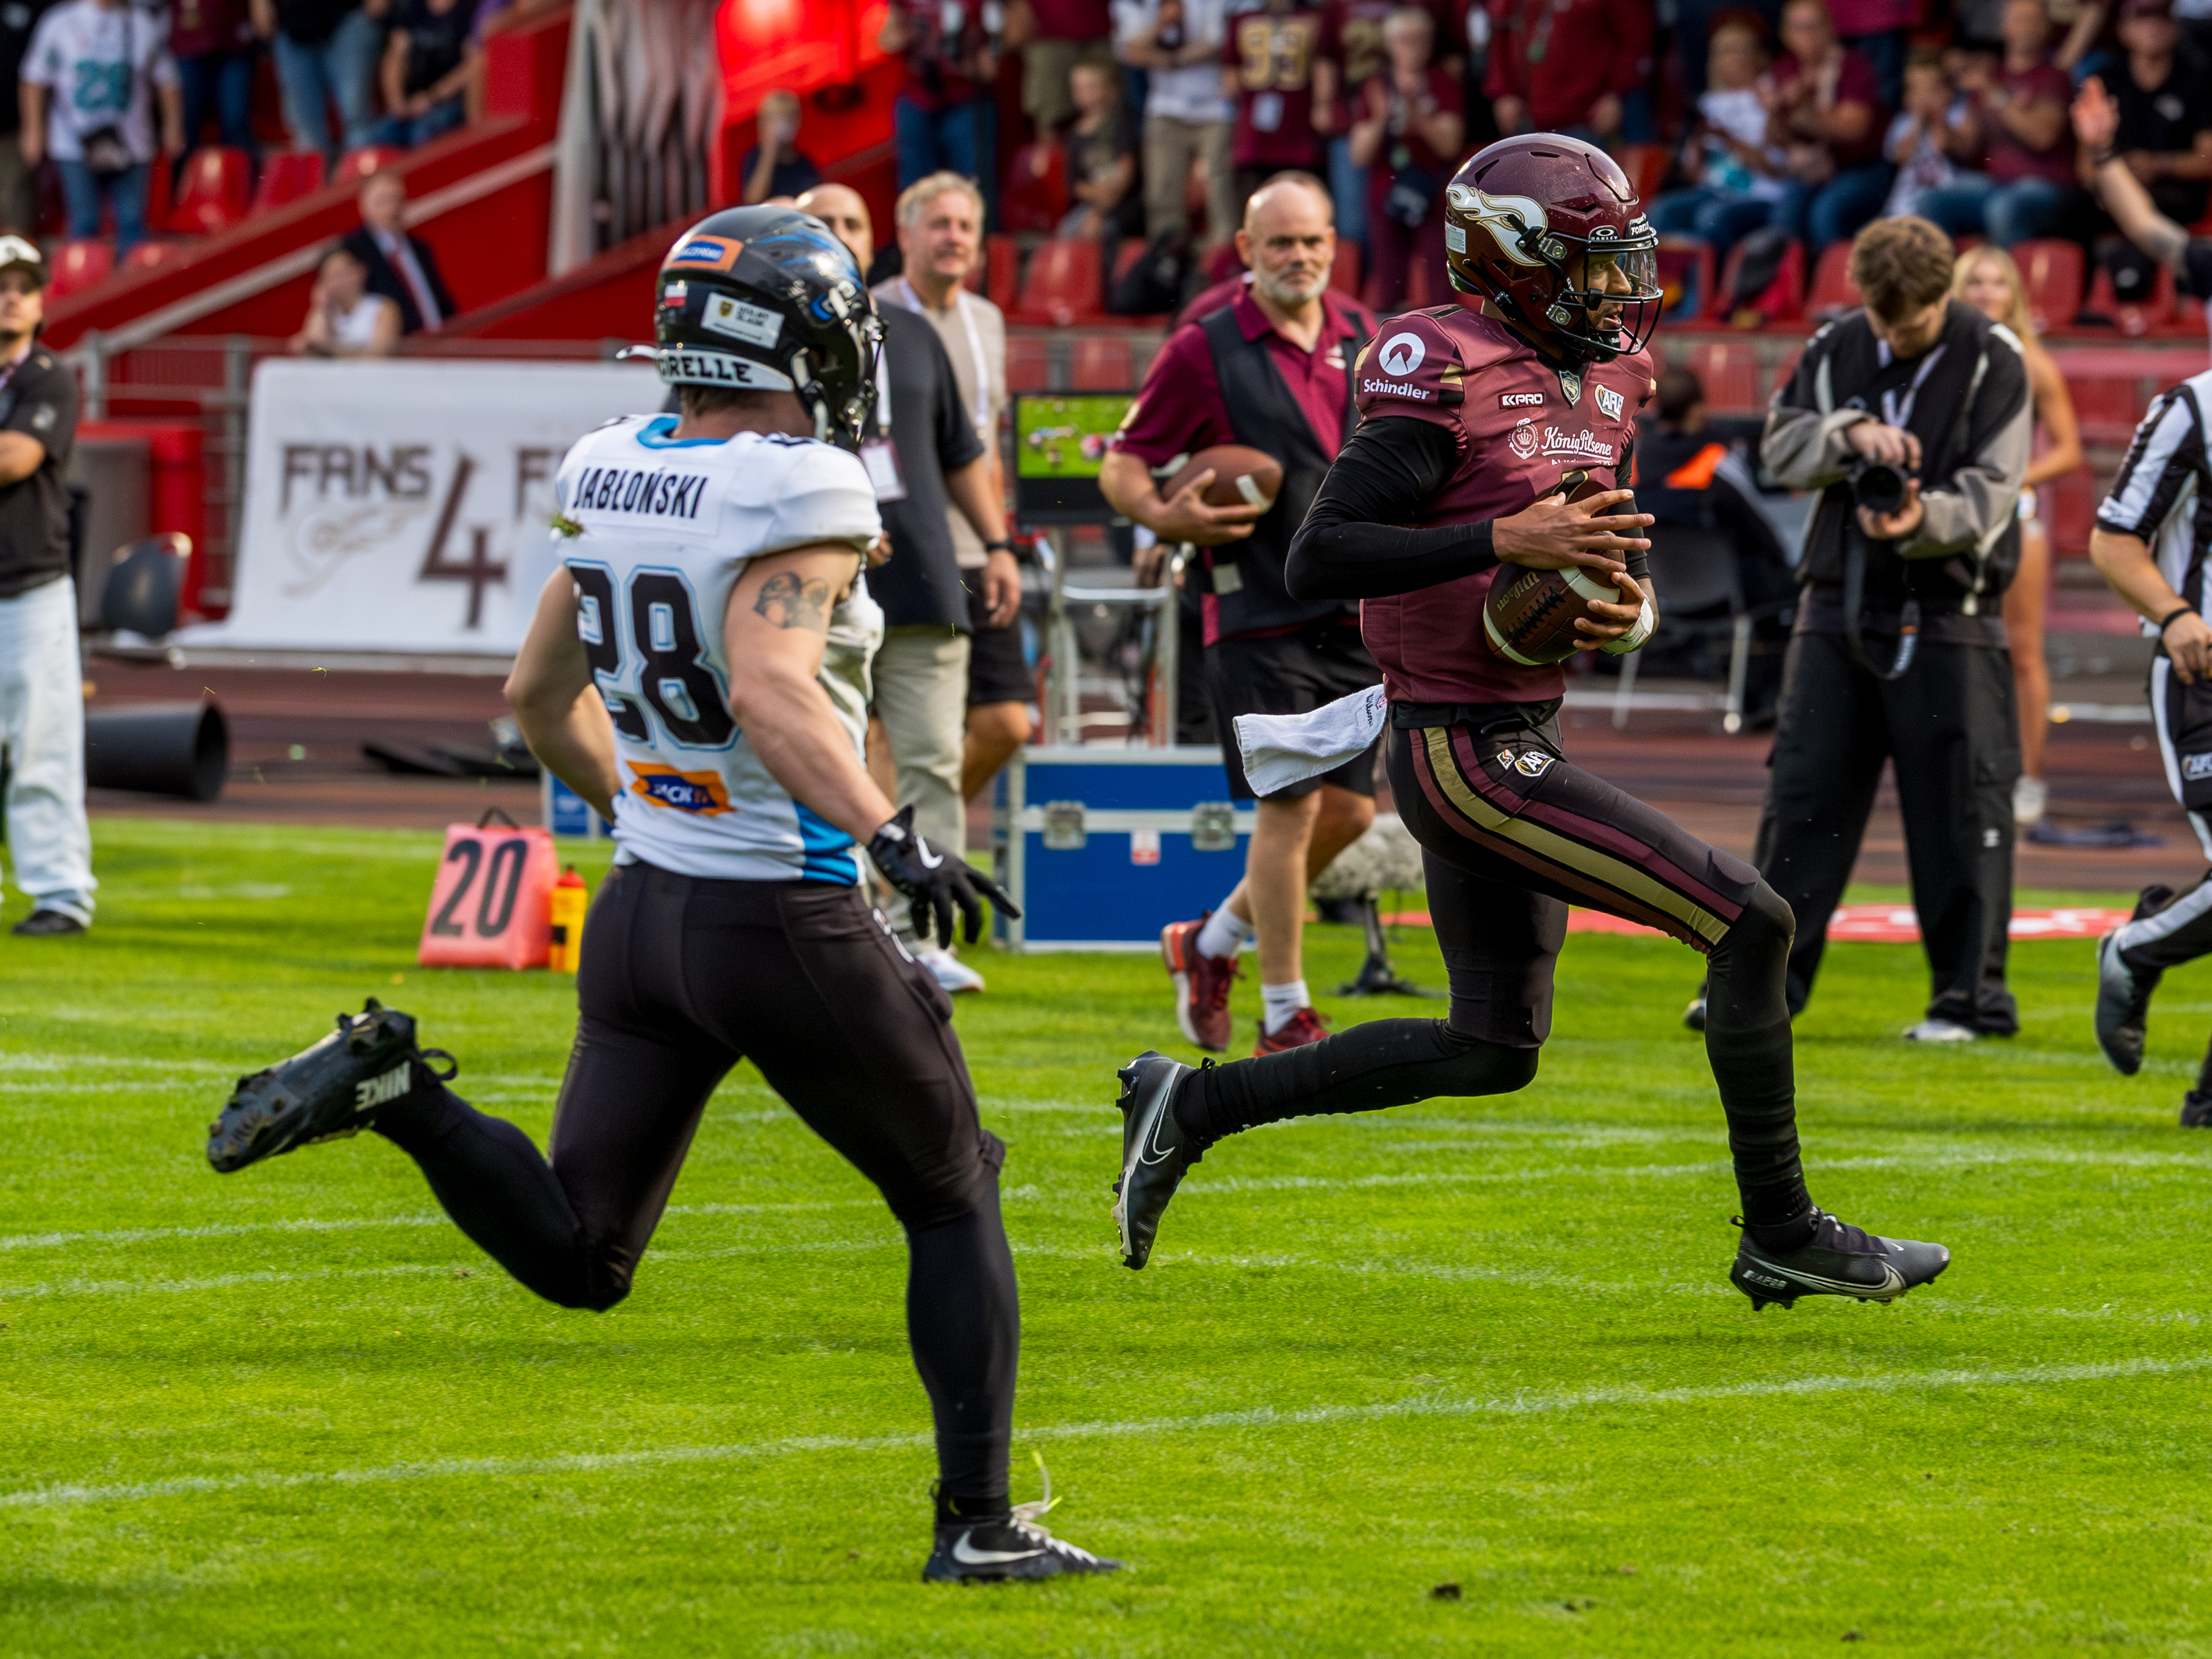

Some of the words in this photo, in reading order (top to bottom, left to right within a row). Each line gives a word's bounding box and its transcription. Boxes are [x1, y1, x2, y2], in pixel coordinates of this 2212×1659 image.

[1364, 378, 1430, 399] Schindler
[573, 466, 708, 519] JABŁOŃSKI
[280, 445, 432, 517] FANS
[418, 452, 510, 629] 4
[1497, 571, 1540, 611] Wilson
[567, 560, 740, 750] 28
[430, 837, 528, 938] 20
[355, 1060, 411, 1112] NIKE
